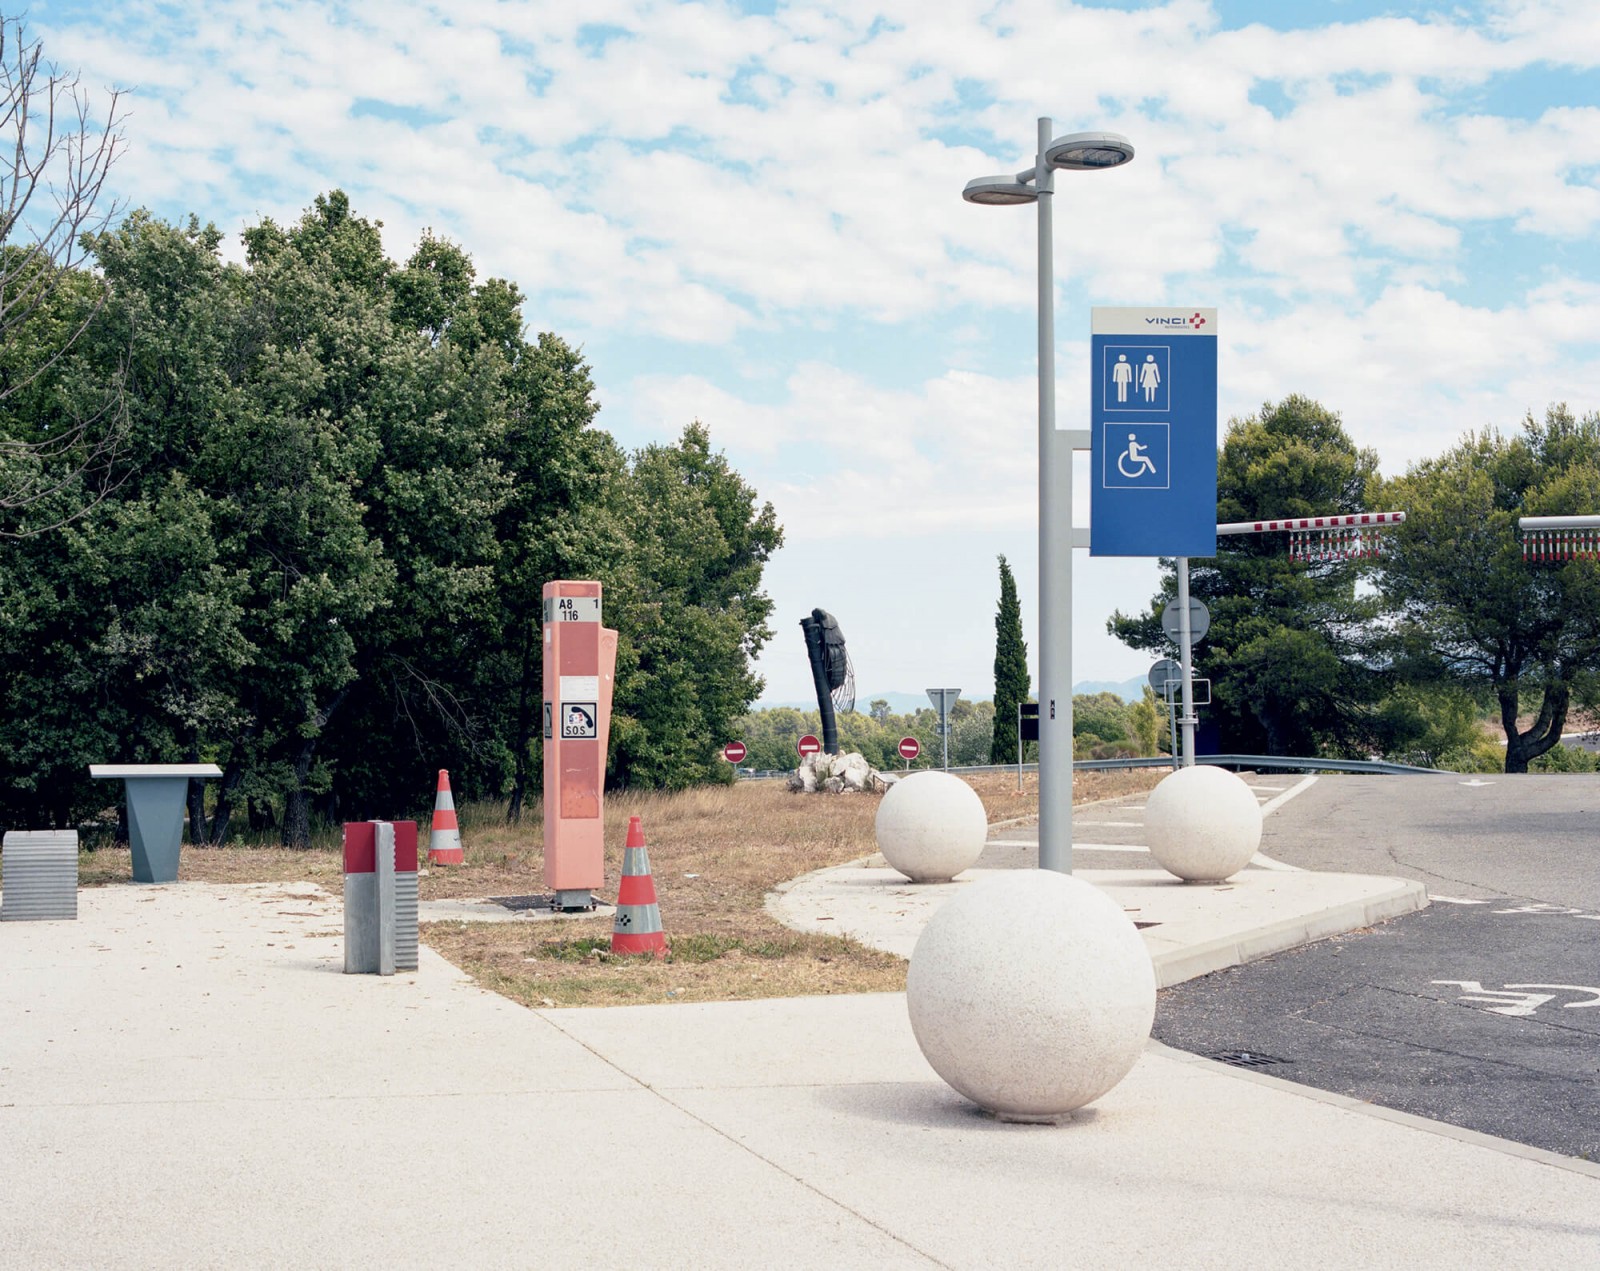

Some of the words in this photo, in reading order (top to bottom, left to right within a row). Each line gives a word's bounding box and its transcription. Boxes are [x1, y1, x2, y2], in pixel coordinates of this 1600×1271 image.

[559, 599, 573, 609] A8
[593, 599, 598, 608] 1
[562, 610, 578, 620] 116
[566, 726, 585, 735] SOS
